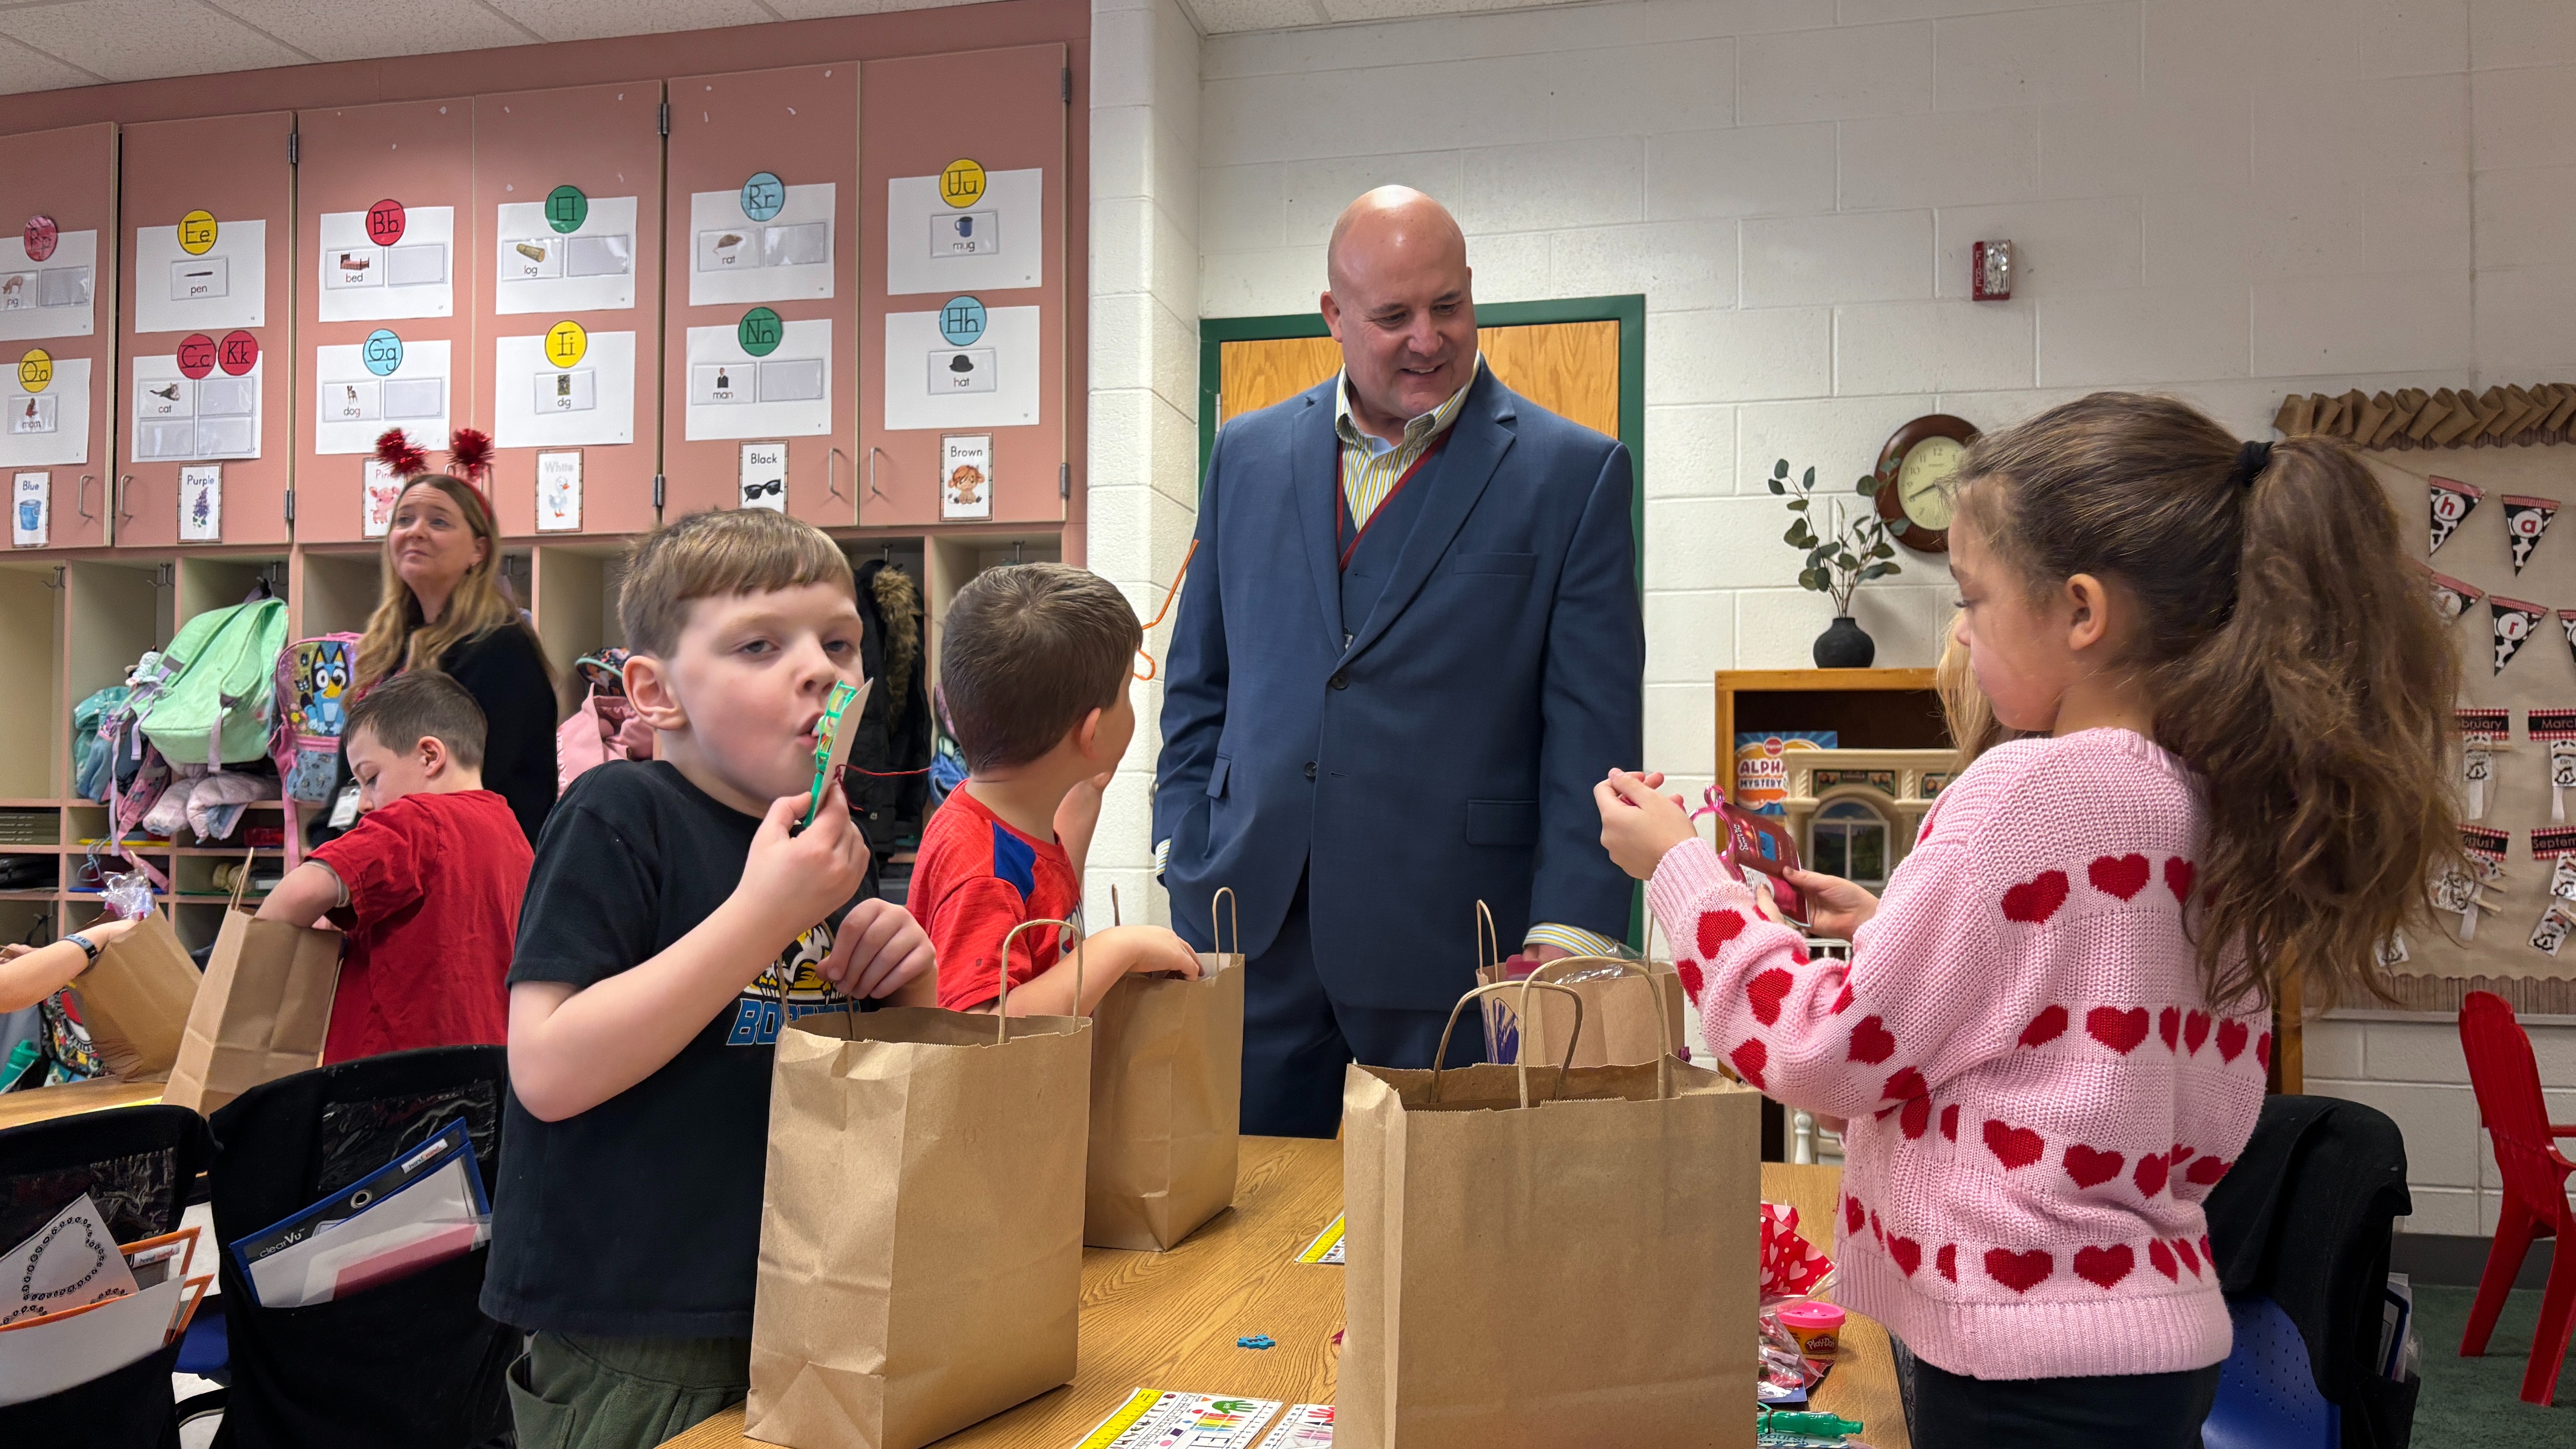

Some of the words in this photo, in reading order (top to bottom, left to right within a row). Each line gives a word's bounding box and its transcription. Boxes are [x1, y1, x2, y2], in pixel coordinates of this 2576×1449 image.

[948, 171, 977, 196] Uu
[750, 185, 777, 209] Rr
[373, 211, 399, 235] Bb
[186, 221, 209, 244] Ee
[952, 241, 975, 252] mug
[722, 255, 736, 265] rat
[524, 265, 538, 276] log
[345, 272, 363, 283] bed
[190, 285, 207, 295] pen
[947, 308, 980, 333] Hh
[746, 319, 774, 344] Nn
[559, 332, 575, 356] Ii
[182, 345, 211, 367] Cc
[227, 341, 249, 364] Kk
[368, 339, 399, 370] Gg
[22, 362, 48, 382] Oo
[953, 377, 969, 387] hat
[713, 391, 733, 399] man
[557, 397, 571, 409] dig
[158, 405, 172, 414] cat
[343, 406, 361, 417] dog
[22, 421, 41, 429] mom
[950, 446, 982, 458] Brown
[1933, 447, 1943, 456] 12
[750, 453, 777, 465] Black
[545, 461, 573, 473] White
[375, 469, 392, 479] Pin
[23, 481, 39, 491] Blue
[187, 475, 214, 488] Purple
[2440, 497, 2454, 515] h
[2521, 518, 2536, 533] a
[2461, 720, 2502, 730] bruary
[2541, 718, 2576, 729] Marc
[1740, 779, 1781, 788] MYSTERY
[2533, 837, 2576, 849] Septem
